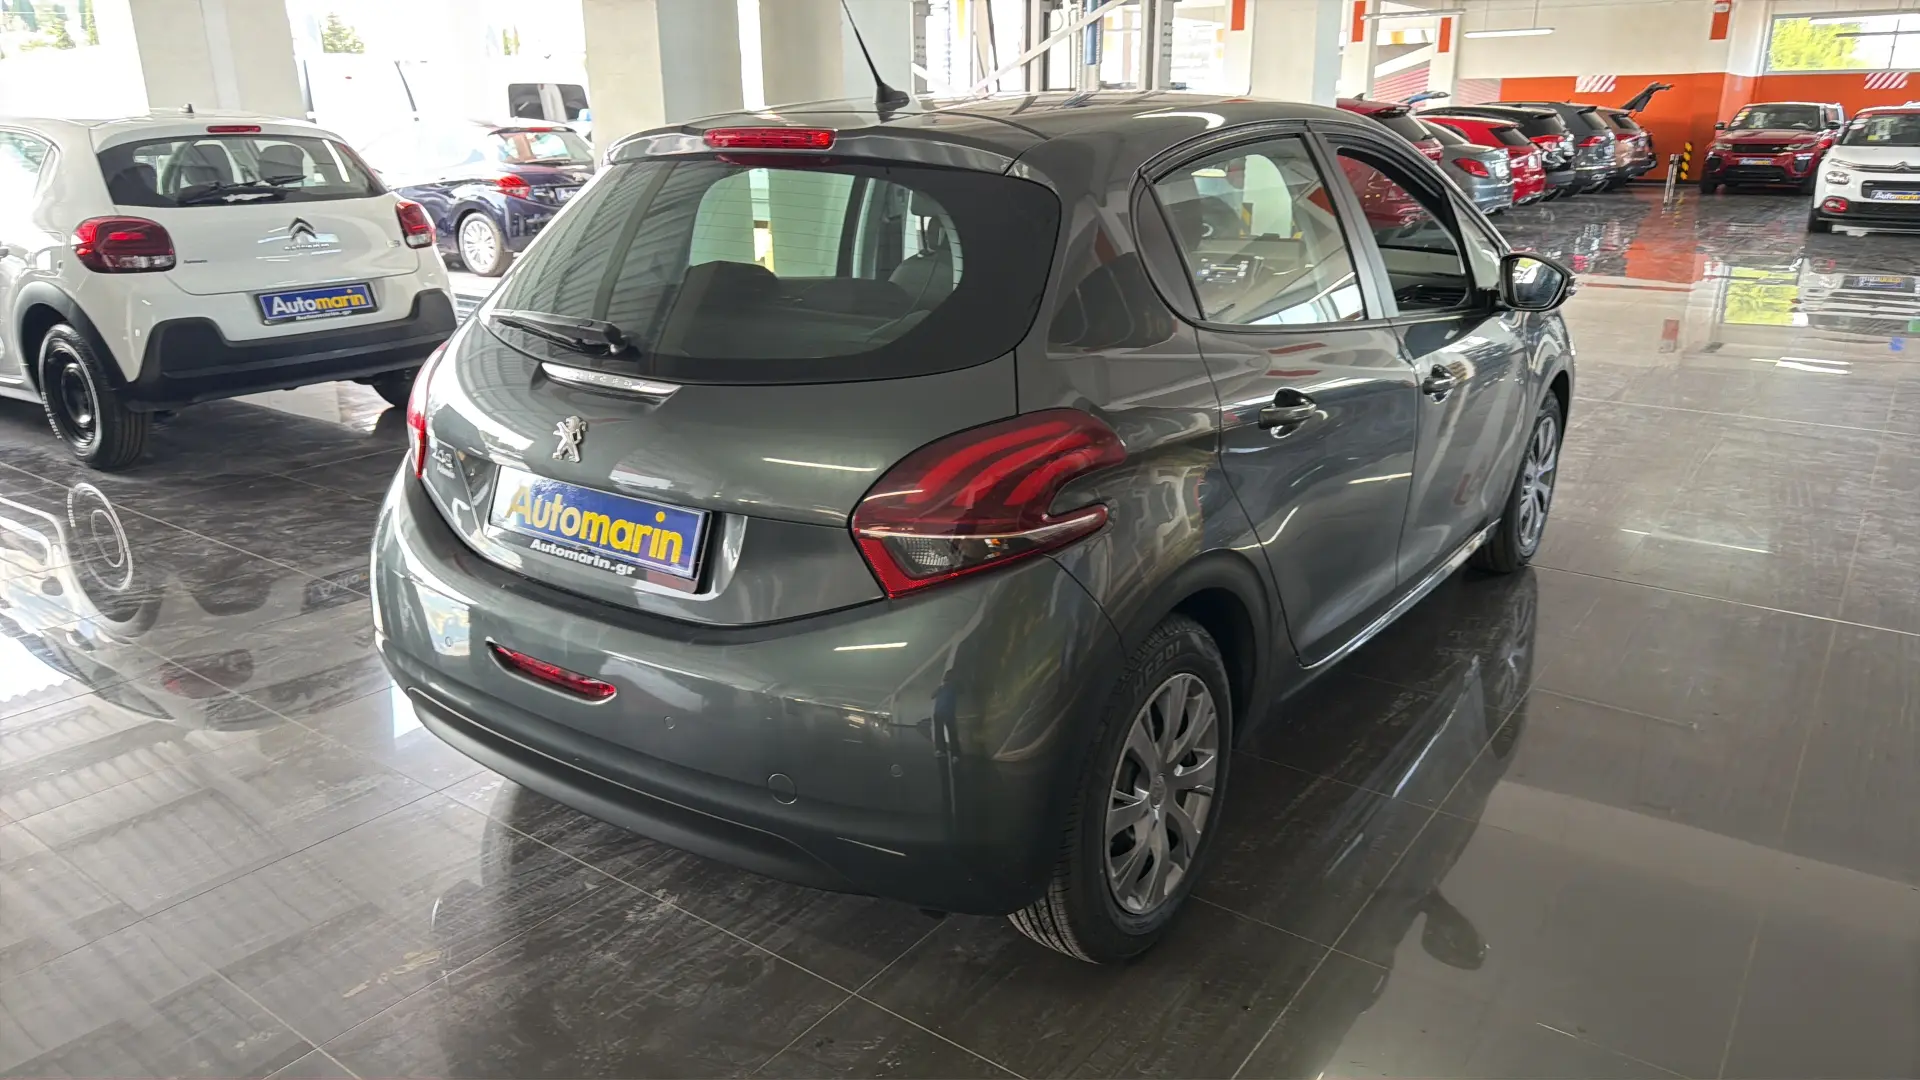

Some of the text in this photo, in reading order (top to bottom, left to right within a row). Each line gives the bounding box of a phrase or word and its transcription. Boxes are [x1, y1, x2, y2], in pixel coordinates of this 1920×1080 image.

[272, 288, 367, 315] Automarin
[504, 484, 683, 564] Automarin
[530, 538, 636, 576] Automarin.gr
